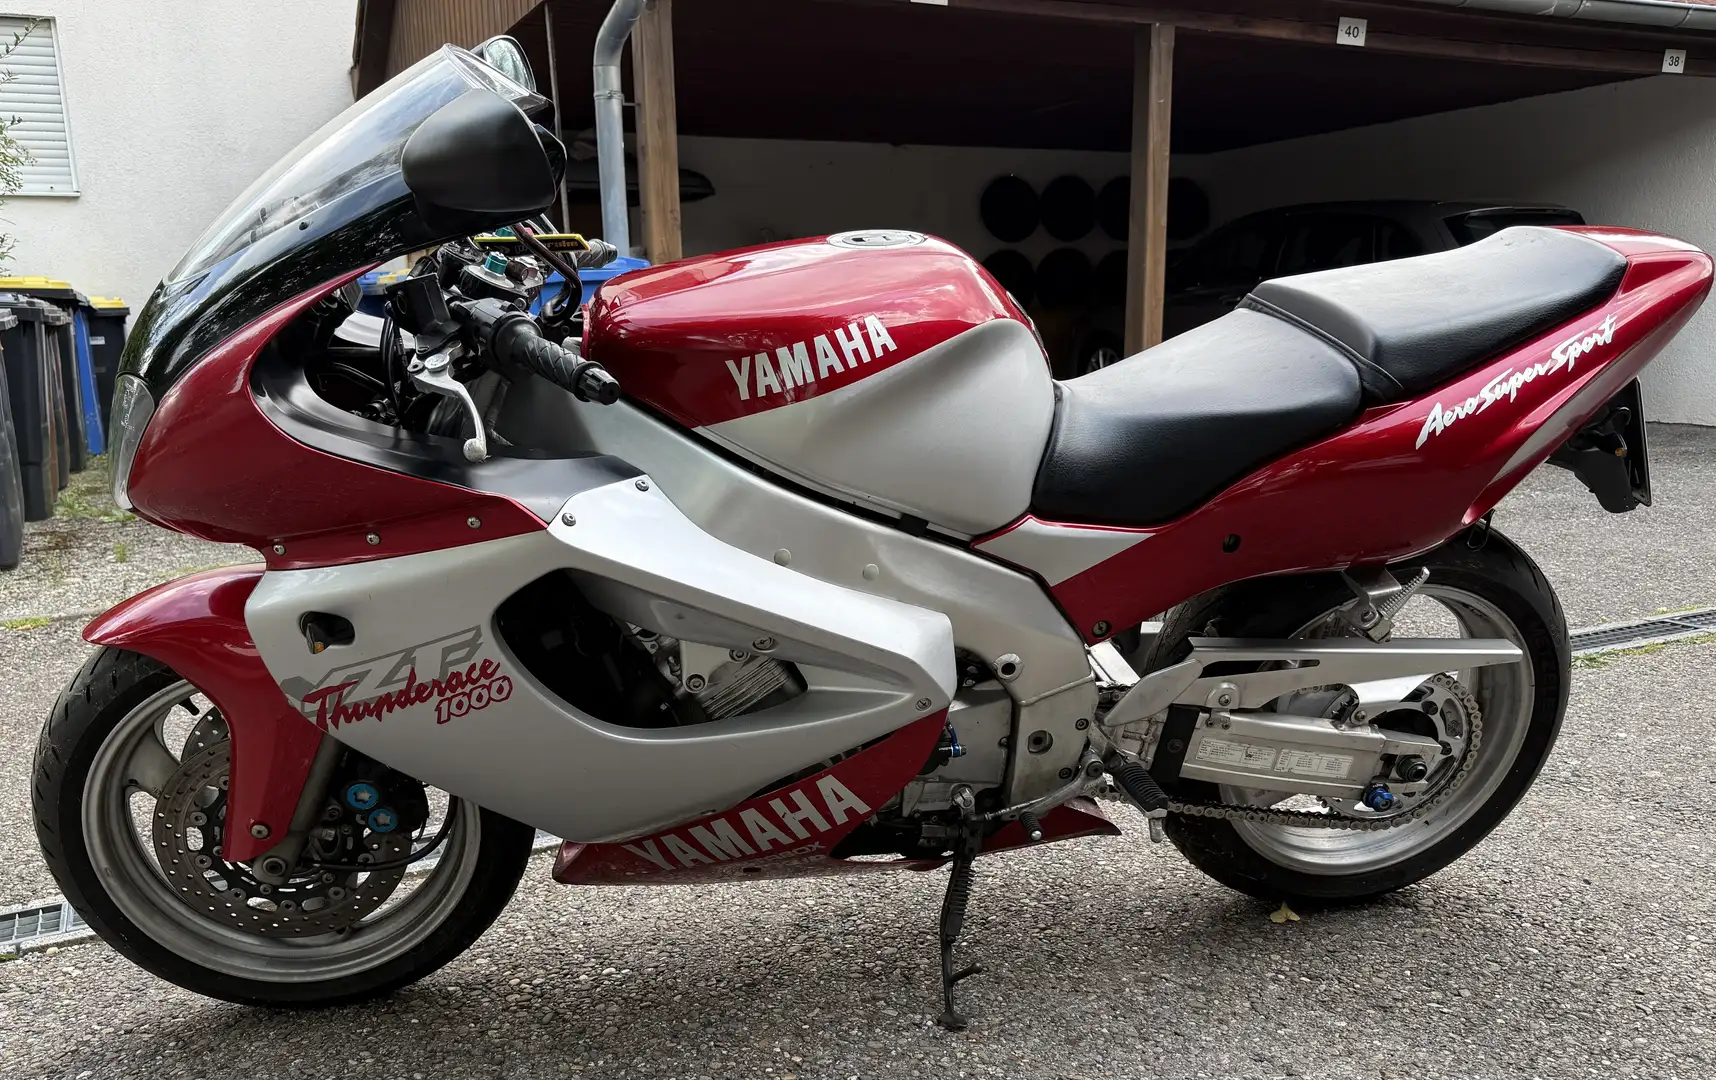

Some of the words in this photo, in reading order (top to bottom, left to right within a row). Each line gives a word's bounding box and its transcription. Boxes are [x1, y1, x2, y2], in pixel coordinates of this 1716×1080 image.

[1344, 25, 1360, 38] 40
[1668, 55, 1680, 66] 38
[725, 313, 897, 400] YAMAHA
[302, 658, 500, 734] Thunderace
[434, 674, 513, 725] 1000
[621, 774, 871, 871] YAMAHA
